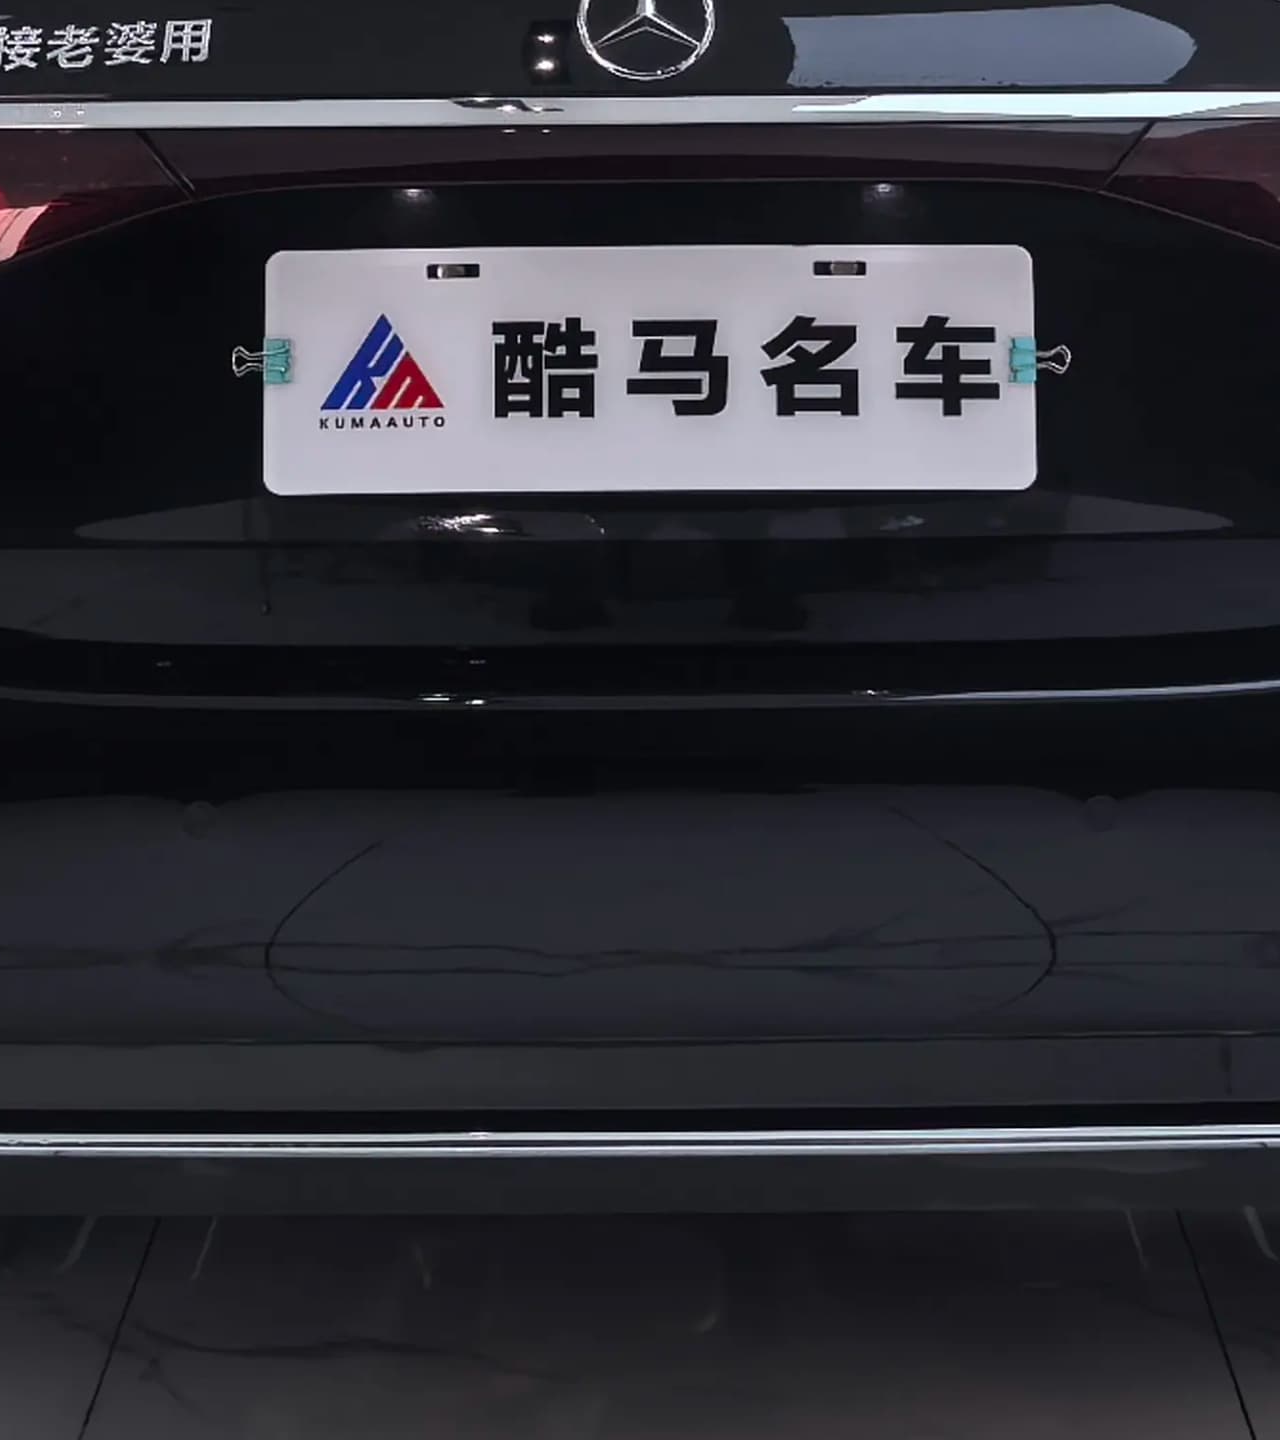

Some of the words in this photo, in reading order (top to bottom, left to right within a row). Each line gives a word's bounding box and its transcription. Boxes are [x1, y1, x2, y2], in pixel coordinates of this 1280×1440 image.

[492, 316, 1001, 418] 酷马名车
[319, 416, 446, 429] KUMAAUTO
